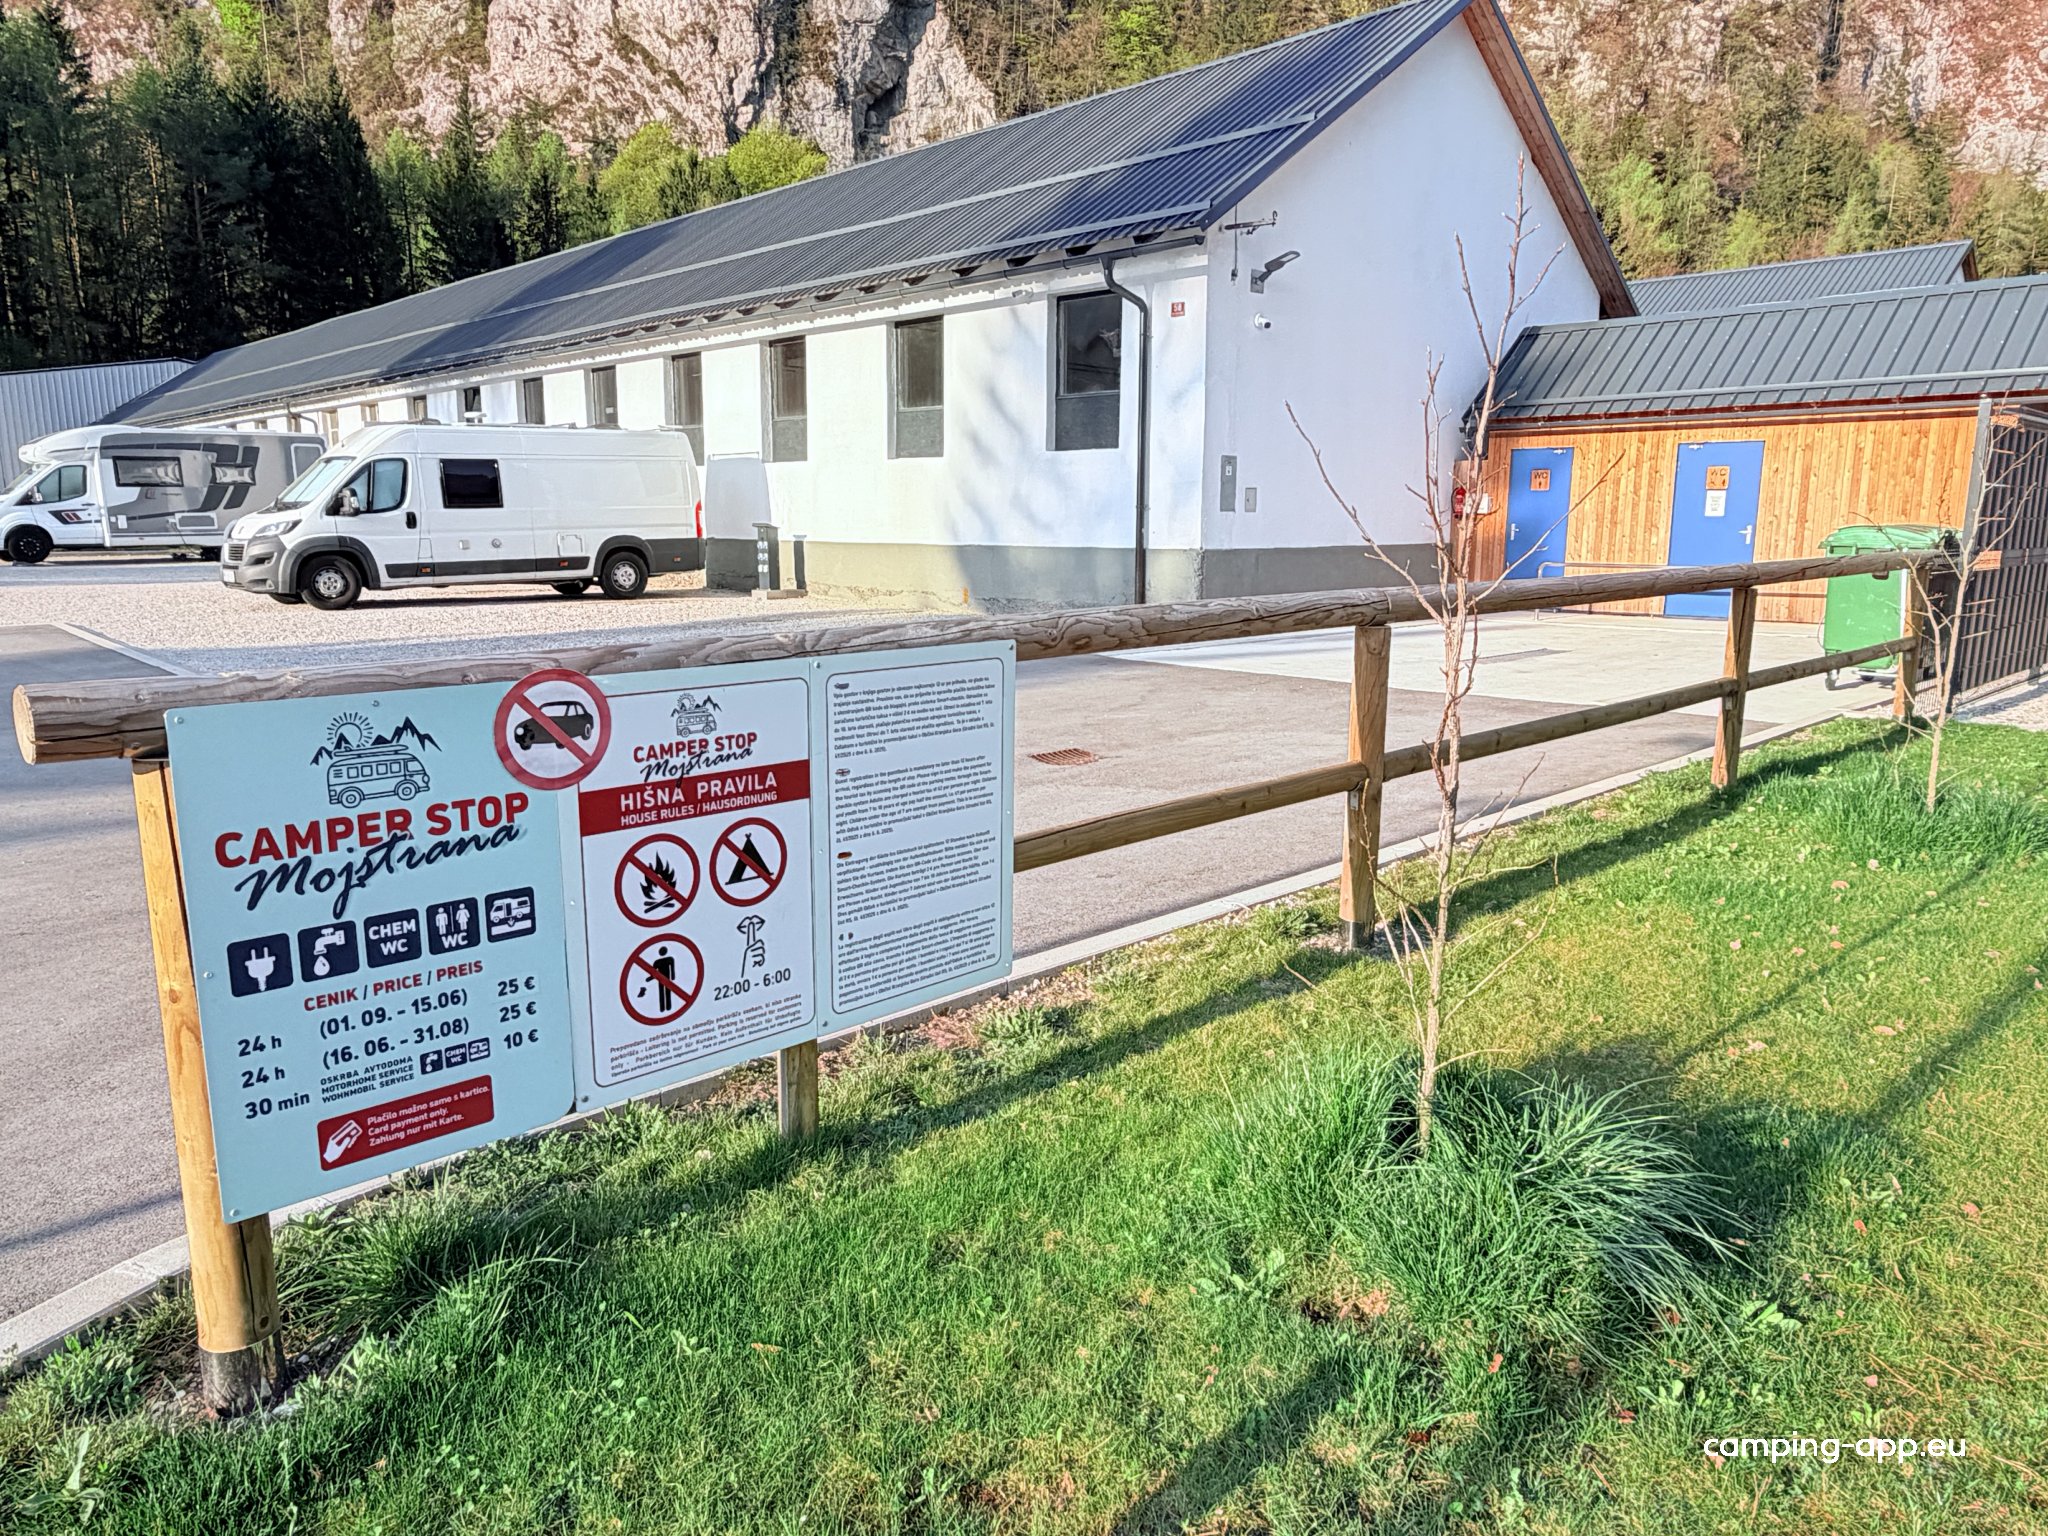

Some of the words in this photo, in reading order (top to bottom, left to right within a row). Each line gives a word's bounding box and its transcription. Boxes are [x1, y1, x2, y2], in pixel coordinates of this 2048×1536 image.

[1534, 471, 1548, 480] WC
[1710, 467, 1728, 477] WC
[633, 738, 709, 763] CAMPER
[714, 731, 757, 752] STOP
[640, 747, 753, 787] Mojstrana
[620, 785, 684, 811] HIŠNA
[696, 771, 777, 799] PRAVILA
[620, 810, 657, 826] HOUSE
[660, 804, 694, 819] RULES
[696, 803, 700, 814] /
[702, 790, 777, 812] HAUSORDNUNG
[214, 808, 414, 868] CAMPER
[425, 791, 528, 835] STOP
[234, 822, 520, 919] Mojstrana
[368, 918, 416, 939] CHEM
[441, 931, 467, 948] WC
[379, 938, 408, 955] WC
[303, 987, 358, 1011] CENIK
[362, 984, 367, 1000] /
[372, 973, 422, 996] PRICE
[426, 970, 431, 985] /
[436, 960, 483, 981] PREIS
[713, 978, 750, 1001] 22:00
[762, 967, 790, 986] 6:00
[237, 1035, 265, 1057] 24
[270, 1035, 281, 1049] h
[319, 1014, 355, 1039] (01.
[361, 1006, 392, 1026] 09.
[410, 988, 467, 1014] 15.06)
[497, 977, 519, 996] 25
[523, 976, 535, 990] €
[241, 1066, 269, 1088] 24
[274, 1066, 285, 1080] h
[322, 1045, 359, 1070] (16.
[364, 1036, 395, 1056] 06.
[413, 1016, 468, 1043] 31.08)
[499, 1003, 520, 1022] 25
[525, 1001, 536, 1015] €
[445, 1047, 465, 1057] CHEM
[503, 1031, 522, 1049] 10
[527, 1028, 538, 1042] €
[320, 1069, 359, 1085] OSKRBA
[363, 1055, 412, 1074] AVTODOMA
[450, 1054, 461, 1063] WC
[321, 1073, 376, 1094] MOTORHOME
[378, 1063, 413, 1079] SERVICE
[321, 1083, 376, 1103] WOHNMOBIL
[379, 1072, 414, 1088] SERVICE
[244, 1097, 272, 1119] 30
[277, 1092, 309, 1110] min
[367, 1111, 397, 1125] Plačilo
[398, 1103, 427, 1116] možno
[428, 1096, 452, 1107] samo
[459, 1085, 489, 1098] kartico.
[367, 1123, 388, 1135] Card
[390, 1112, 427, 1131] payment
[429, 1107, 448, 1118] only.
[369, 1130, 405, 1146] Zahlung
[406, 1125, 421, 1135] nur
[422, 1120, 437, 1130] mit
[438, 1114, 464, 1125] Karte.
